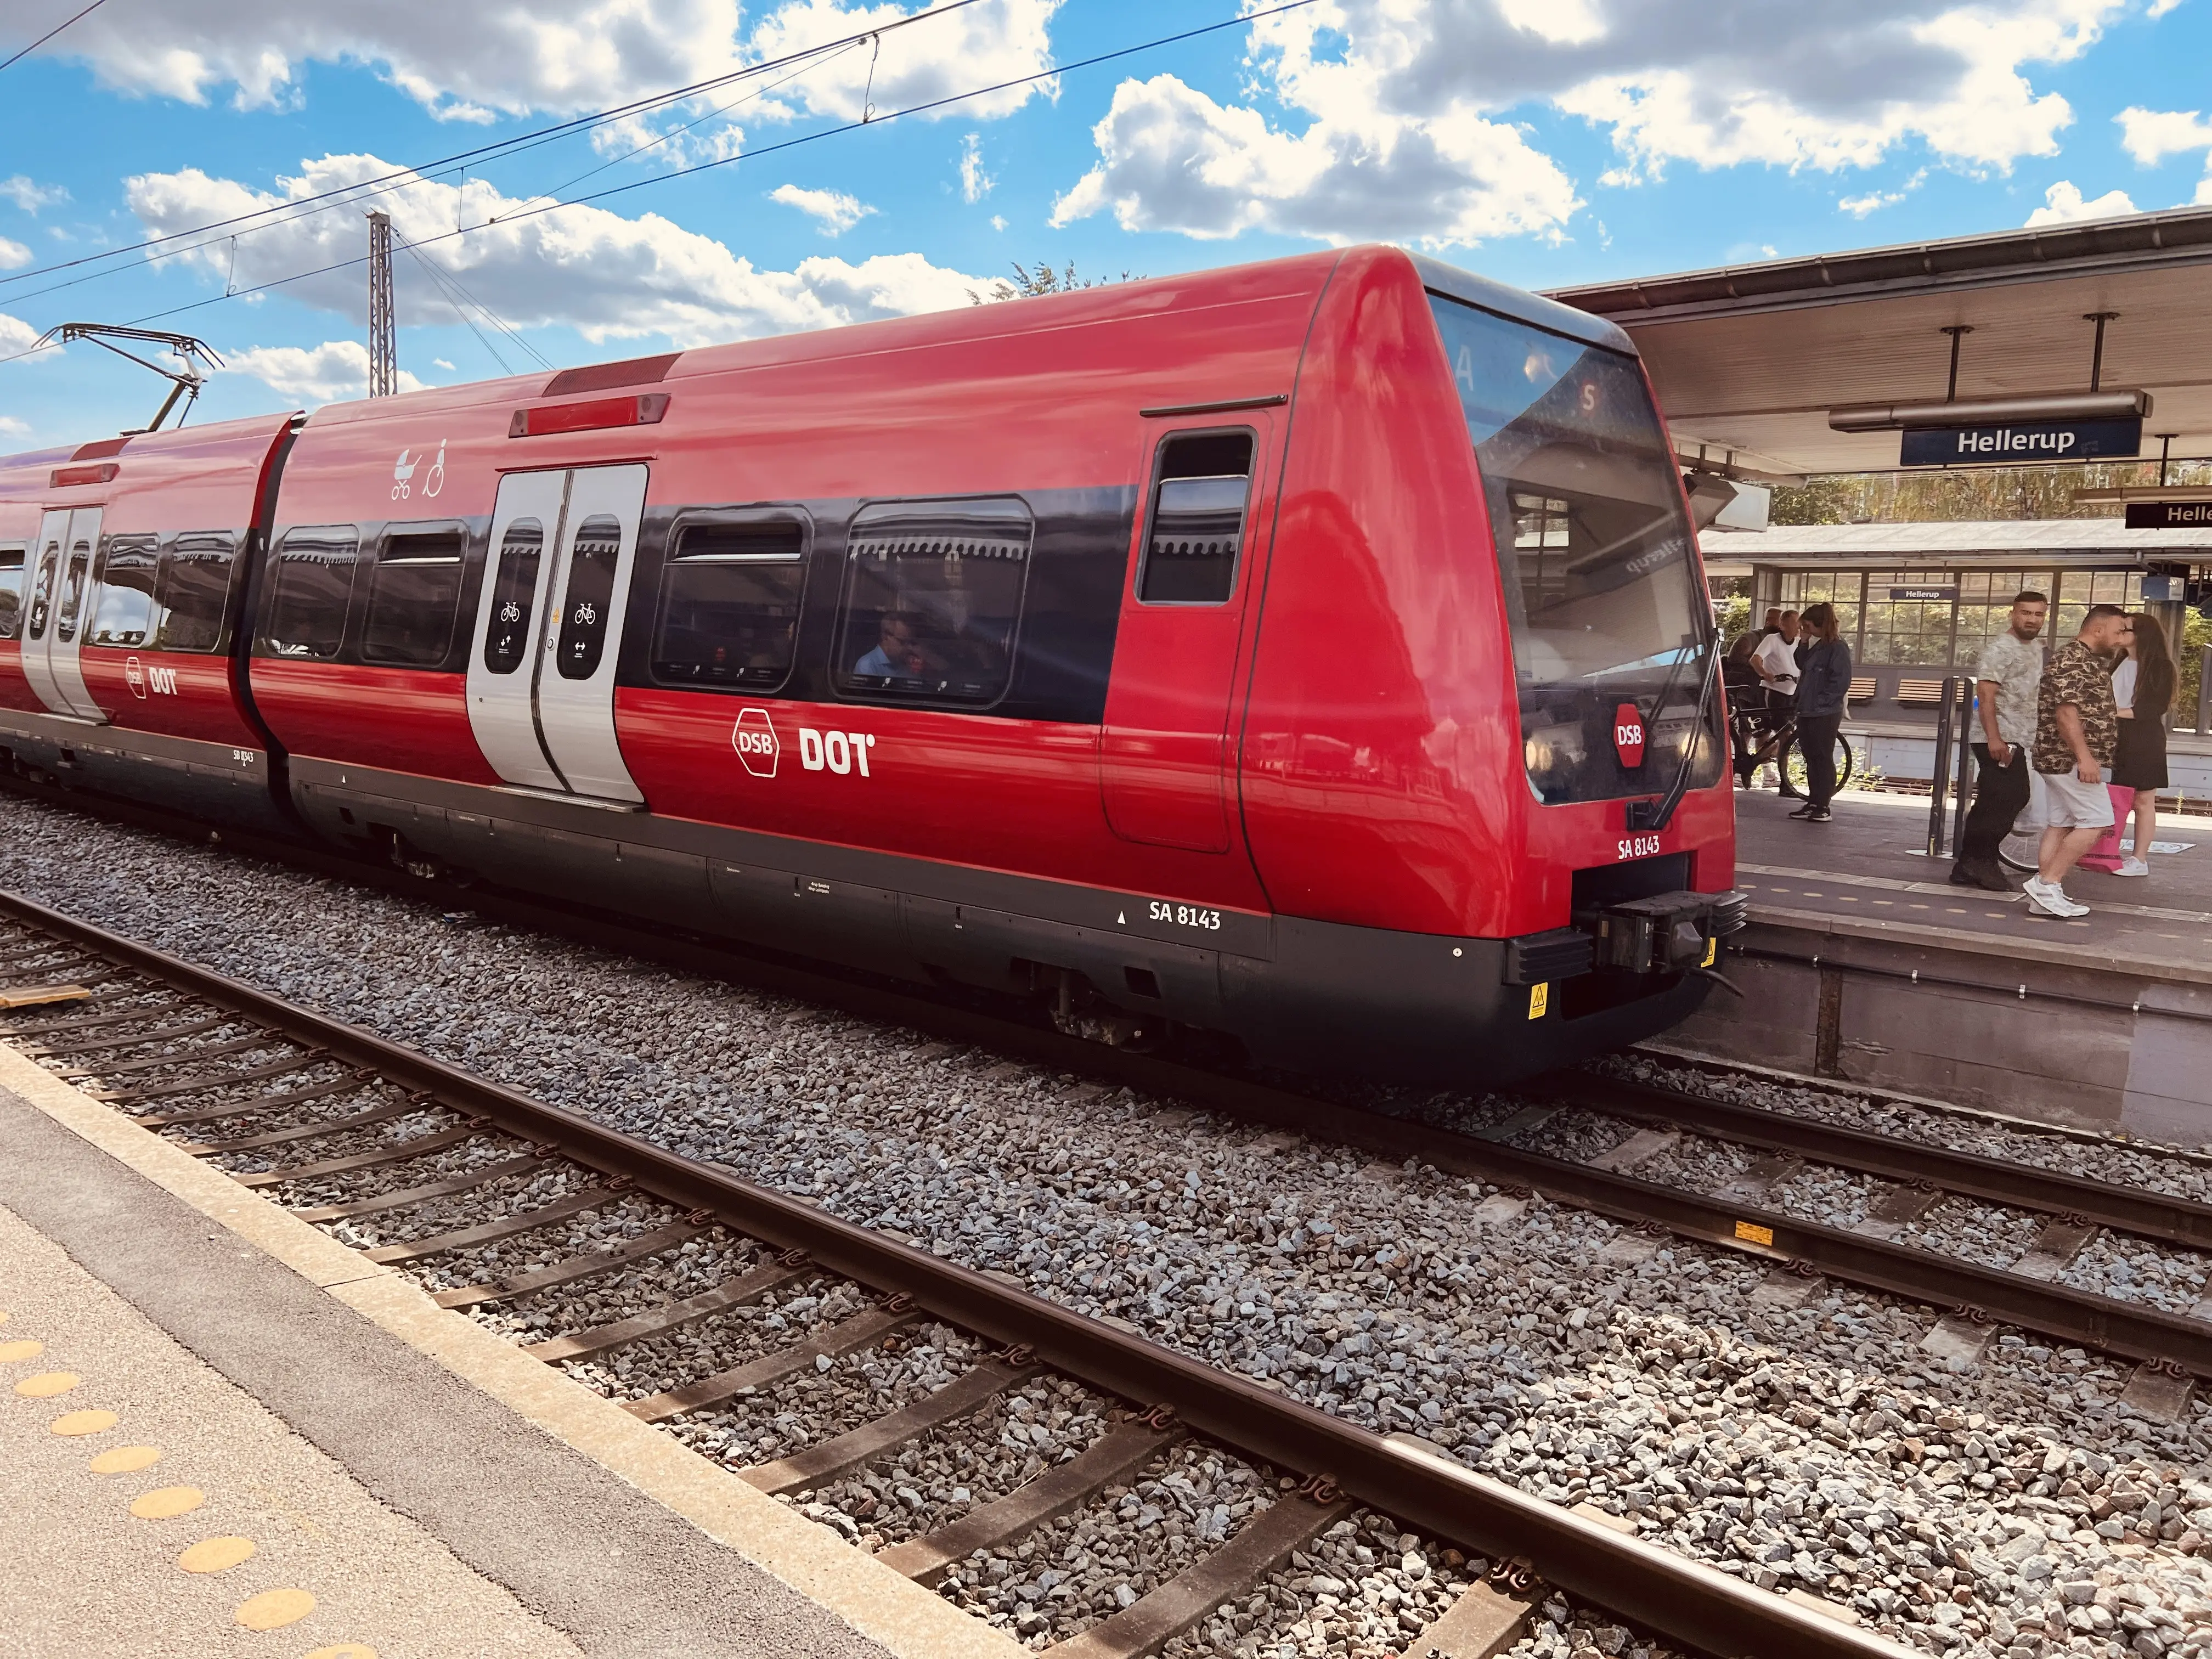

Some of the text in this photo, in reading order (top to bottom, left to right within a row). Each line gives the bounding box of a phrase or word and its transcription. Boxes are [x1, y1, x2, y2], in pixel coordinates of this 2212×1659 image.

[1582, 383, 1596, 410] S
[1957, 429, 2075, 454] Hellerup
[1905, 590, 1940, 599] Hellerup
[127, 670, 143, 685] DSB
[148, 666, 178, 695] DOT
[738, 731, 774, 755] DSB
[1617, 725, 1642, 746] DSB
[798, 727, 876, 777] DOT
[1618, 835, 1660, 860] SA 8143
[1149, 901, 1221, 930] SA 8143
